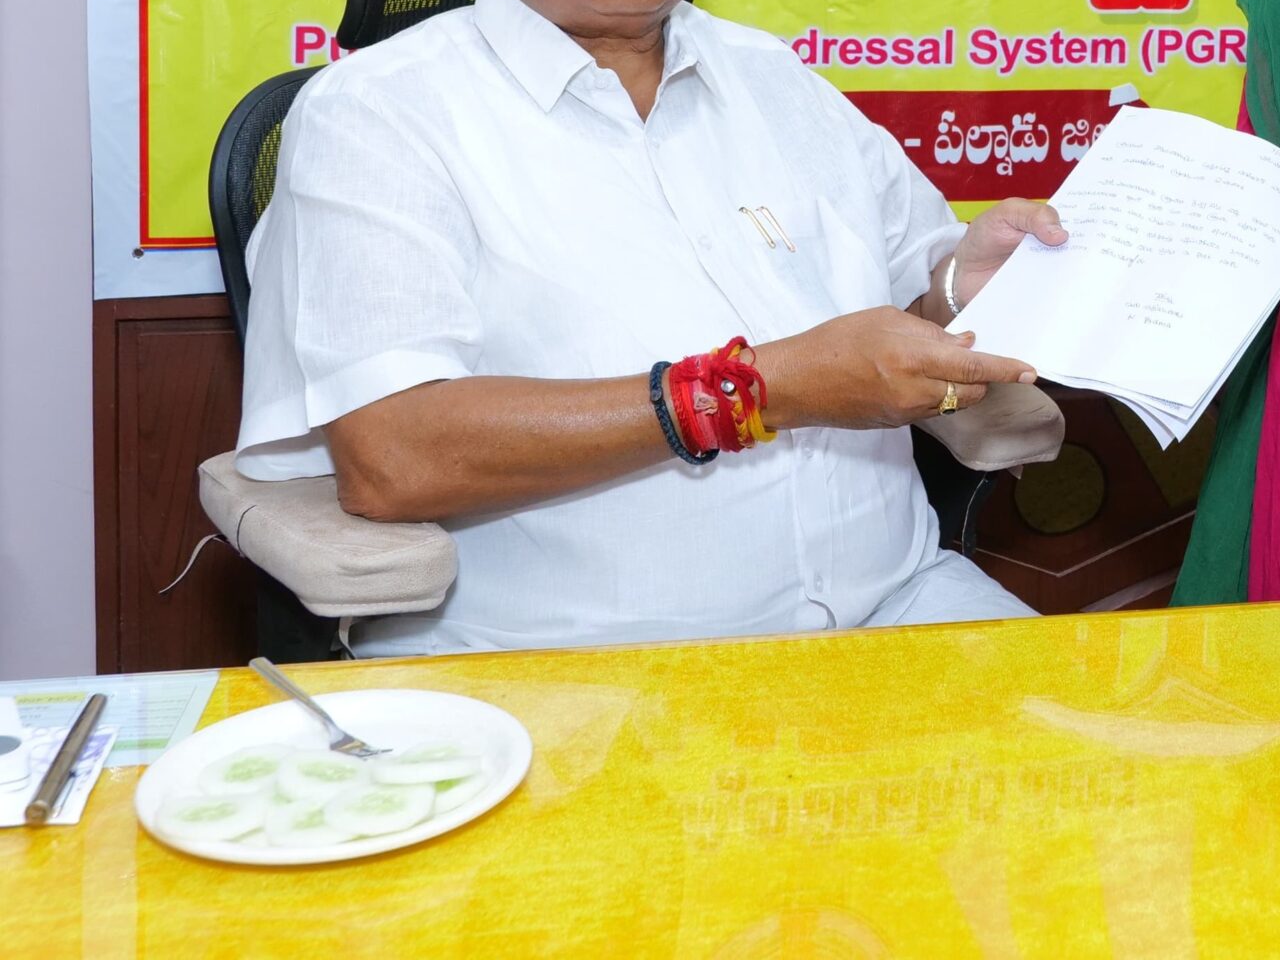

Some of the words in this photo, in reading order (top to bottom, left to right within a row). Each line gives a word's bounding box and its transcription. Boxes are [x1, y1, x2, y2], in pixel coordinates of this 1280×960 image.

[791, 29, 954, 66] dressal
[969, 29, 1126, 74] System
[1142, 29, 1247, 73] (PGR
[934, 110, 1050, 176] పల్నాడు
